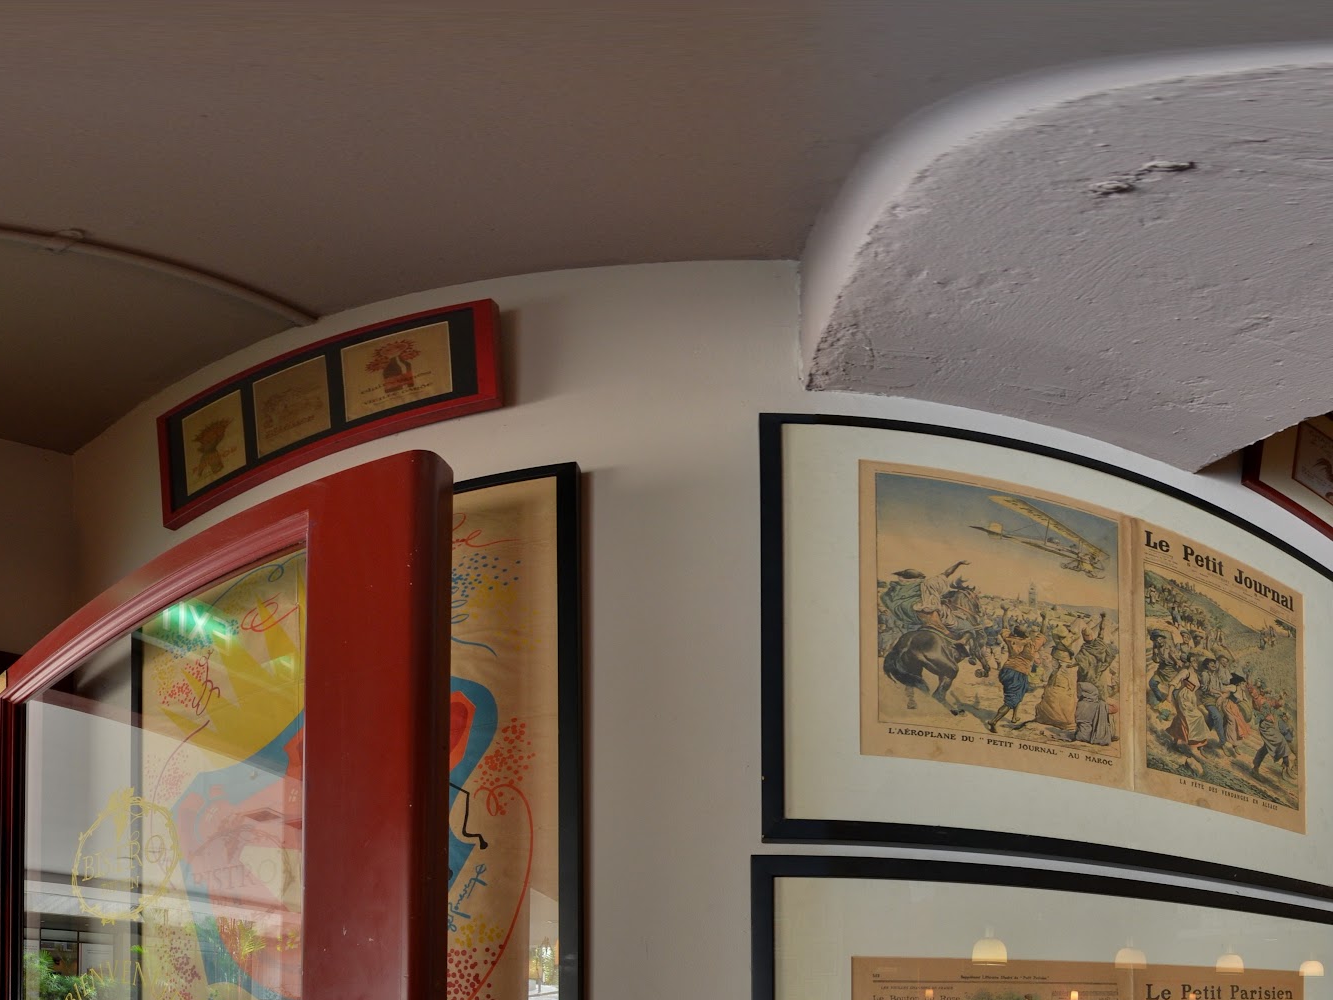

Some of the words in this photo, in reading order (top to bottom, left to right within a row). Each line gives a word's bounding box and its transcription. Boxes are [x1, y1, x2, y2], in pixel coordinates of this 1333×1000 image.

[1144, 530, 1170, 553] Le
[1182, 544, 1224, 577] Petit
[1234, 568, 1294, 612] Journal
[888, 727, 957, 741] L'AÉROPLANE
[961, 734, 975, 743] DU
[987, 738, 1014, 748] PETIT
[1018, 743, 1058, 756] JOURNAL
[1068, 752, 1080, 760] AU
[1085, 755, 1113, 766] MAROC
[1208, 786, 1218, 794] DES
[1221, 790, 1249, 802] VENDANGES
[81, 834, 166, 882] BISTRO
[1145, 984, 1171, 1000] Le
[1181, 984, 1222, 1000] Petit
[1230, 984, 1293, 1000] Parisien
